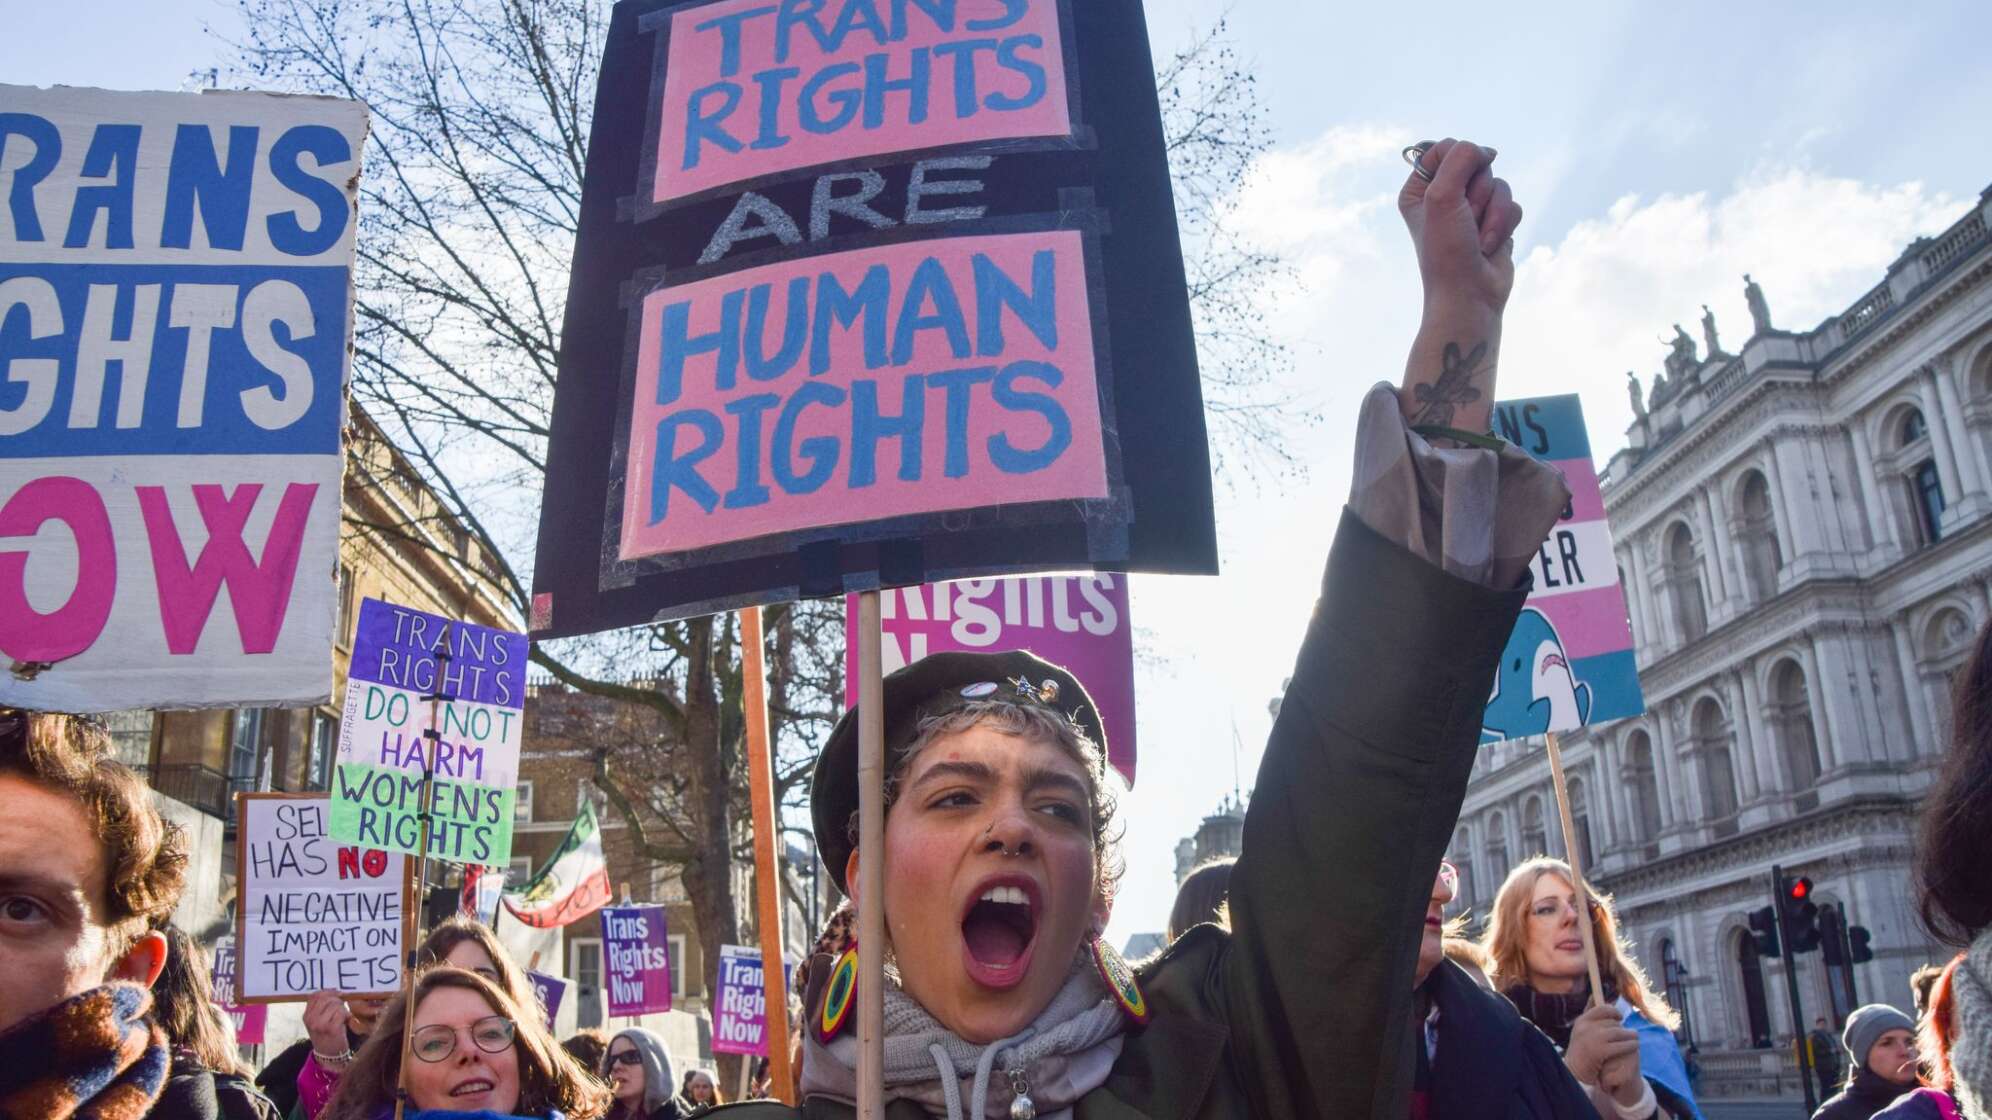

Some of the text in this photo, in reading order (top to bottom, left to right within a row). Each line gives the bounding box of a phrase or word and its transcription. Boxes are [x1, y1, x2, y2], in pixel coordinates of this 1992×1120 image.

[681, 34, 1048, 171] RIGHTS
[697, 155, 996, 264] ARE
[656, 250, 1058, 405] HUMAN
[647, 361, 1073, 528] RIGHTS
[394, 610, 508, 666] TRANS
[379, 648, 512, 706] RIGHTS
[365, 686, 516, 744] DO NOT
[380, 731, 484, 781] HARM
[338, 765, 503, 824] WOMEN'S
[358, 807, 492, 860] RIGHTS
[251, 839, 388, 880] HAS NO
[261, 892, 400, 925] NEGATIVE
[603, 910, 649, 939] Trans
[267, 927, 397, 955] IMPACT ON
[608, 941, 666, 978] Rights
[262, 955, 398, 991] TOILETS
[611, 975, 644, 1004] Now
[719, 1013, 762, 1044] Now
